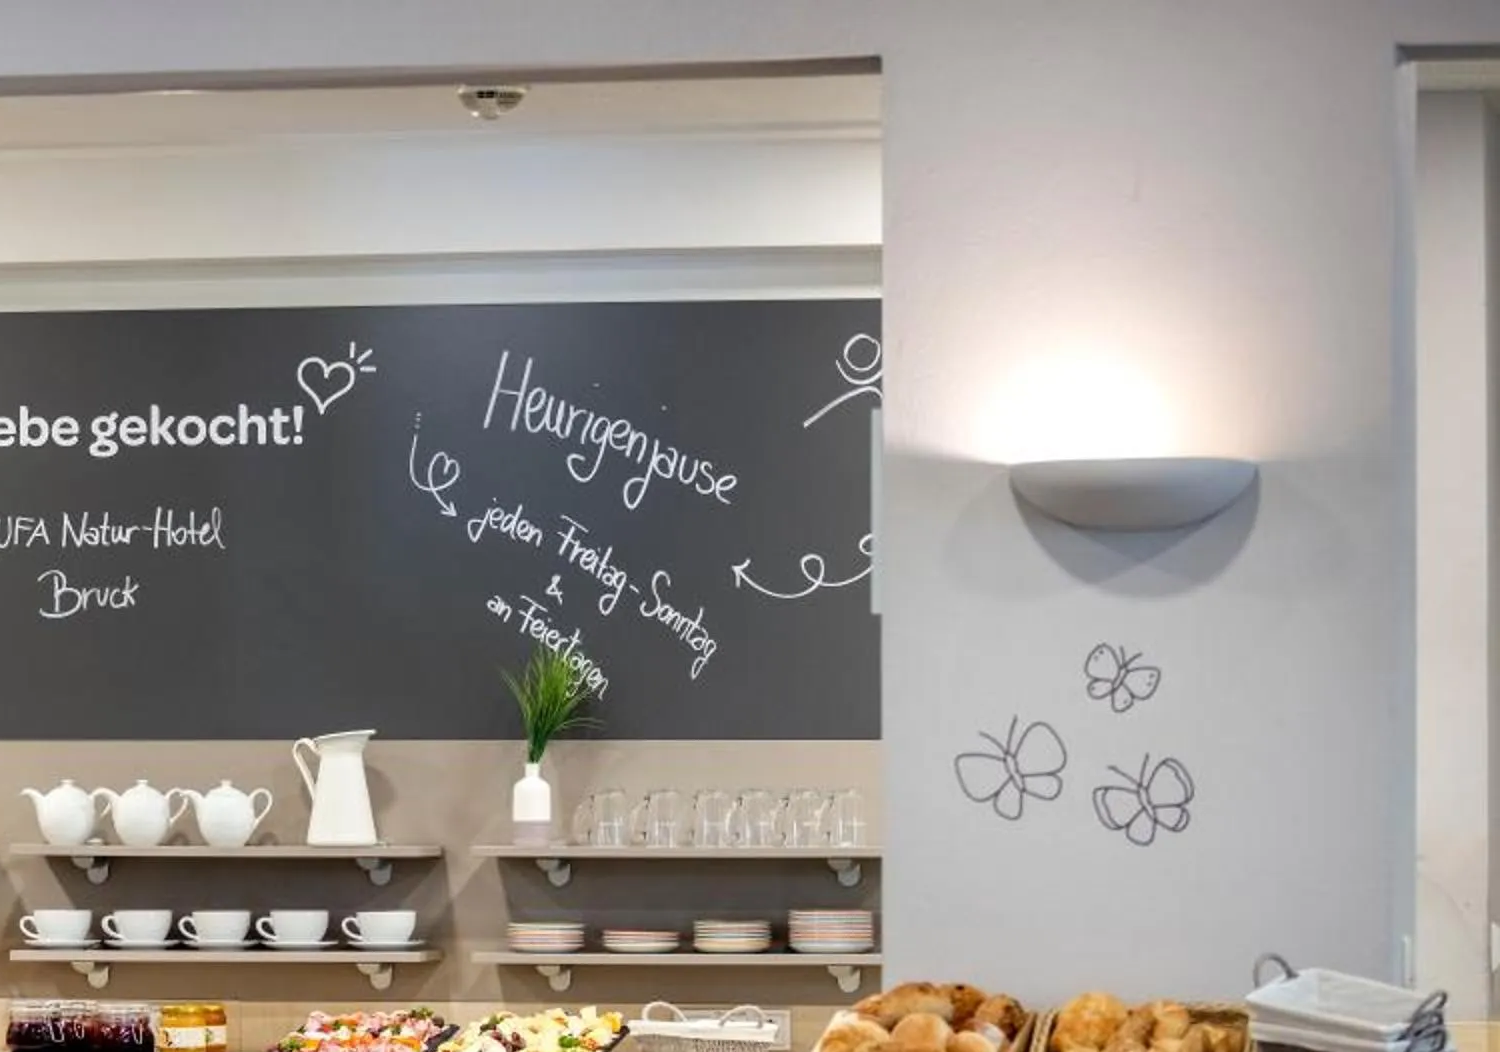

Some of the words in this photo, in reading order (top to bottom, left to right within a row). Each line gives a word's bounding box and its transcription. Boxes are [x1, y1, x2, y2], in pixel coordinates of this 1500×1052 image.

[88, 403, 304, 458] gekocht!
[483, 350, 738, 510] Heurigenjause
[467, 497, 544, 546] jeden
[37, 569, 140, 619] Bruck
[486, 594, 513, 623] an
[545, 574, 564, 605] &
